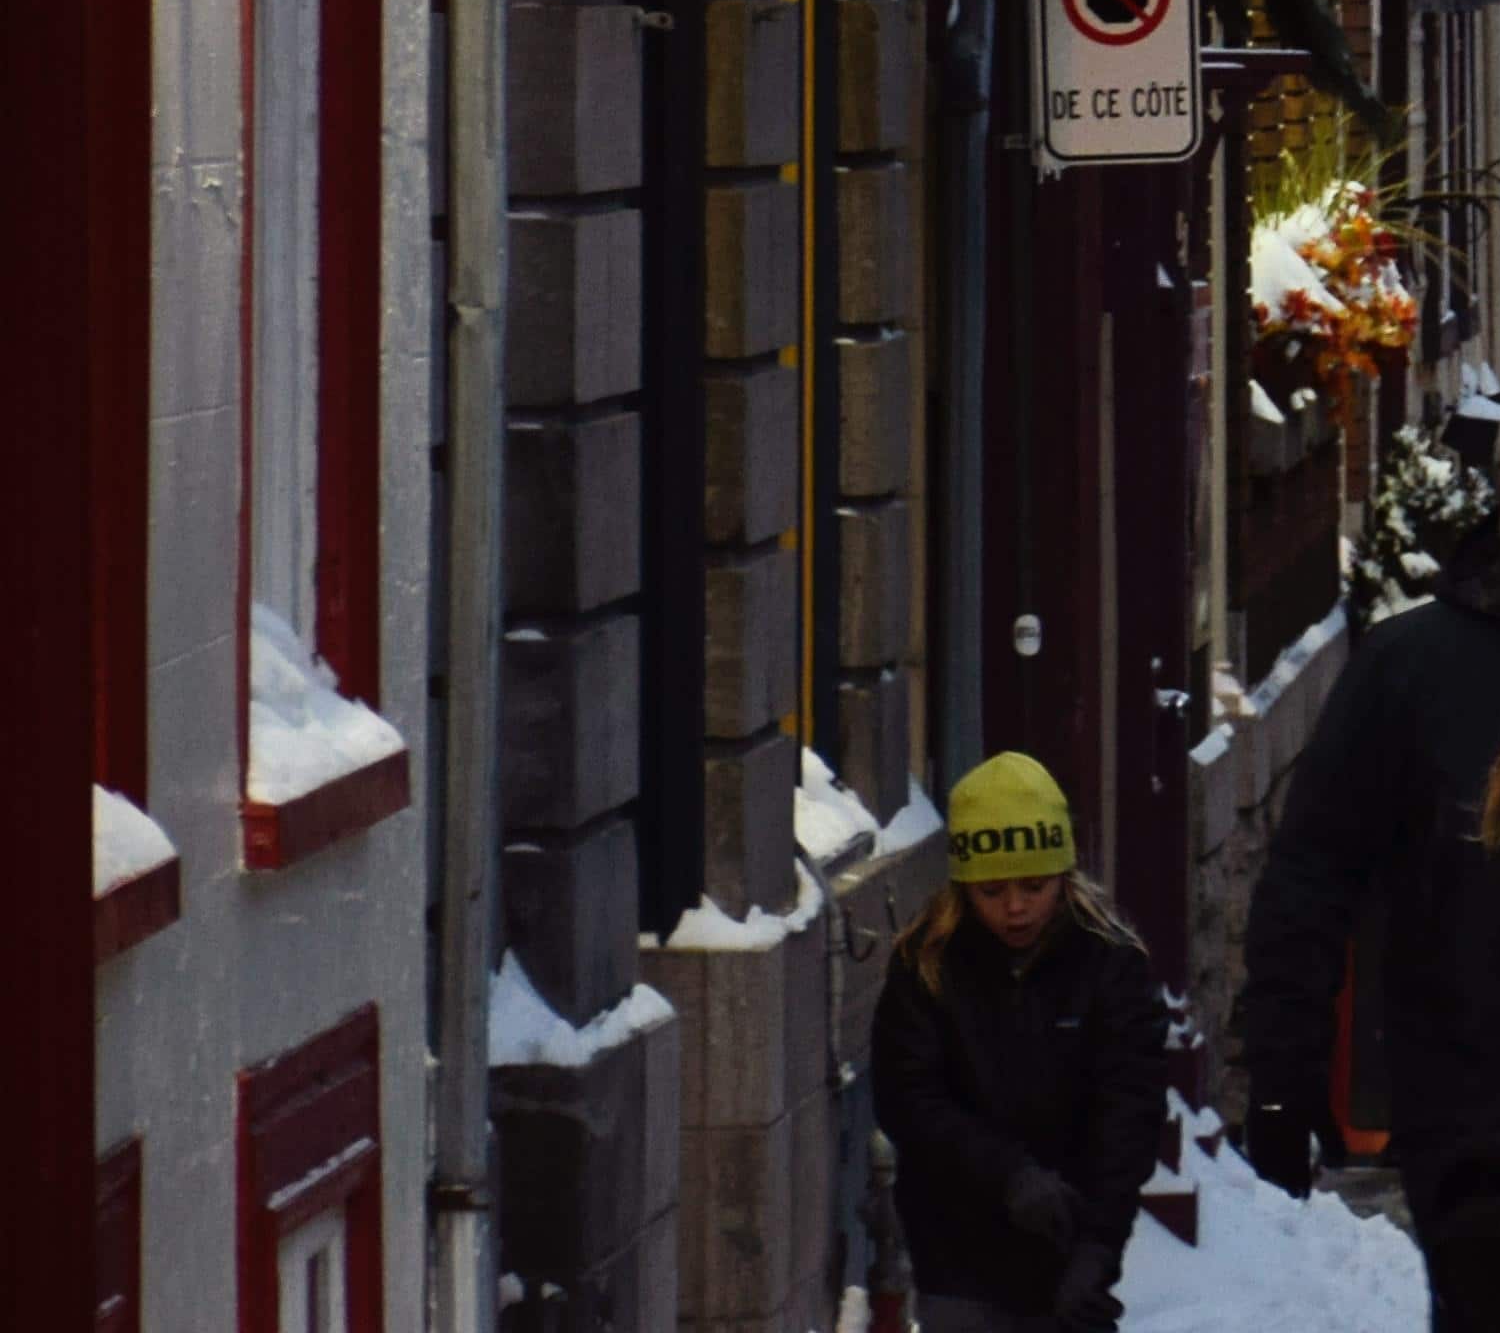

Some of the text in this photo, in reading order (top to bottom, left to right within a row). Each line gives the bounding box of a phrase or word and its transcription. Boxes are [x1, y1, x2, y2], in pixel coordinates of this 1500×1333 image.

[1052, 81, 1188, 119] DE CE CÔTÉ
